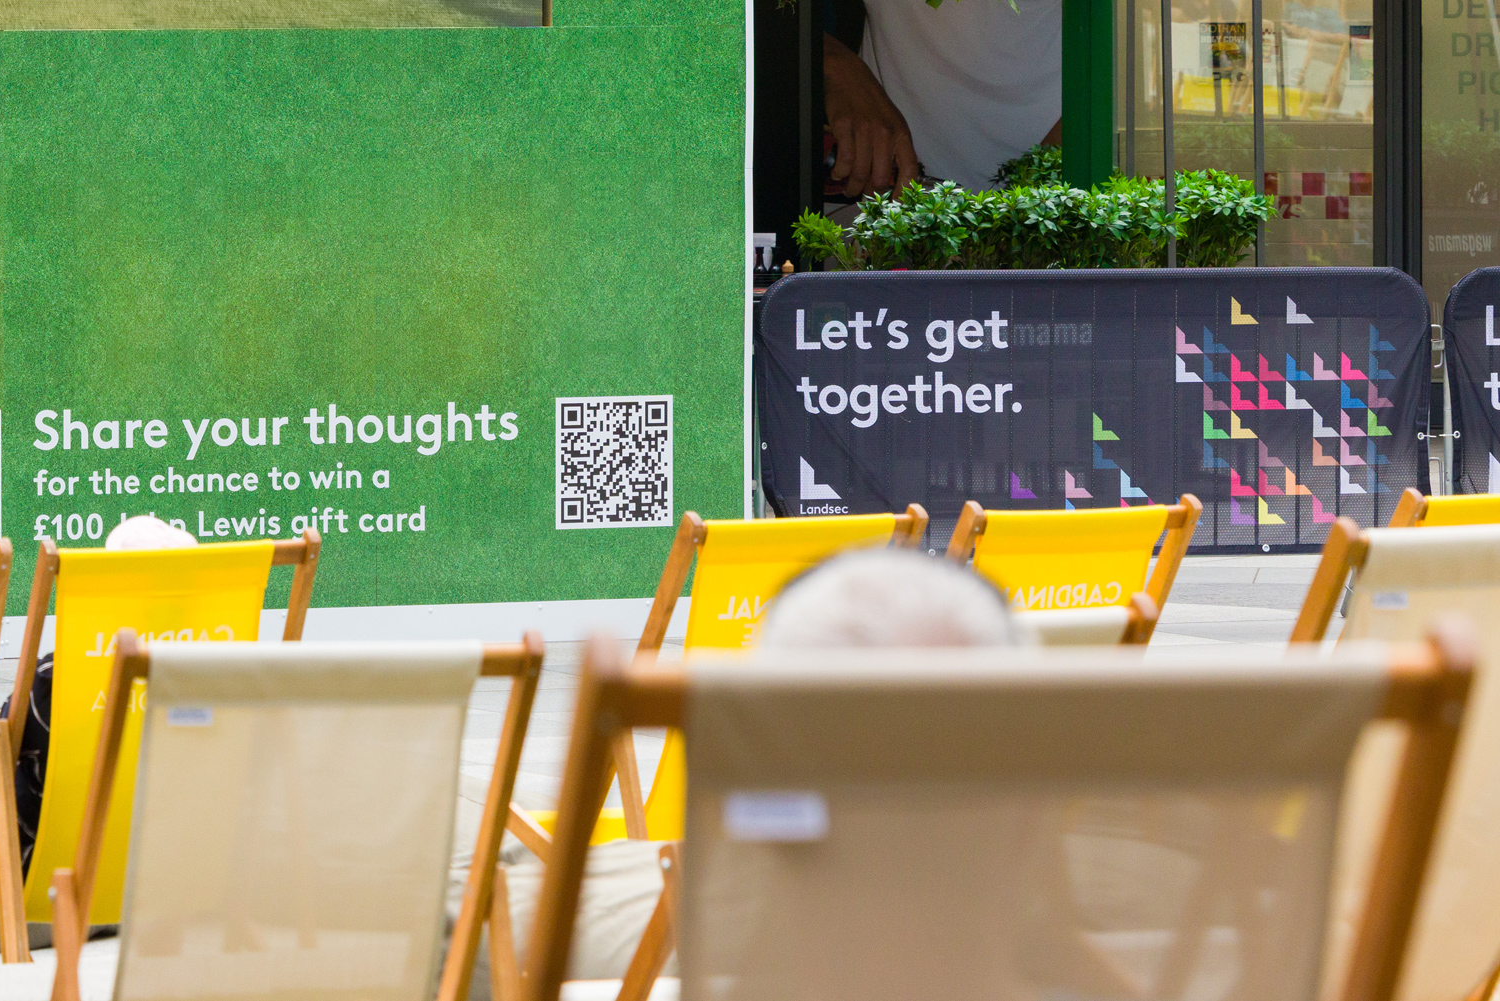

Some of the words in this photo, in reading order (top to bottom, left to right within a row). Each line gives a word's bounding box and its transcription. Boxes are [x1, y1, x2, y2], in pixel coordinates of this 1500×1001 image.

[796, 308, 910, 350] Let's
[925, 310, 1009, 363] get
[796, 371, 1023, 429] together.
[33, 409, 169, 451] Share
[181, 416, 290, 461] your
[303, 401, 520, 456] thoughts
[33, 469, 80, 496] for
[89, 468, 141, 495] the
[150, 466, 259, 494] chance
[268, 466, 300, 491] to
[308, 462, 362, 490] win
[372, 469, 390, 489] a
[33, 513, 104, 541] £100
[198, 507, 281, 537] Lewis
[290, 506, 349, 541] gift
[358, 505, 426, 533] card
[799, 503, 849, 515] Landsec
